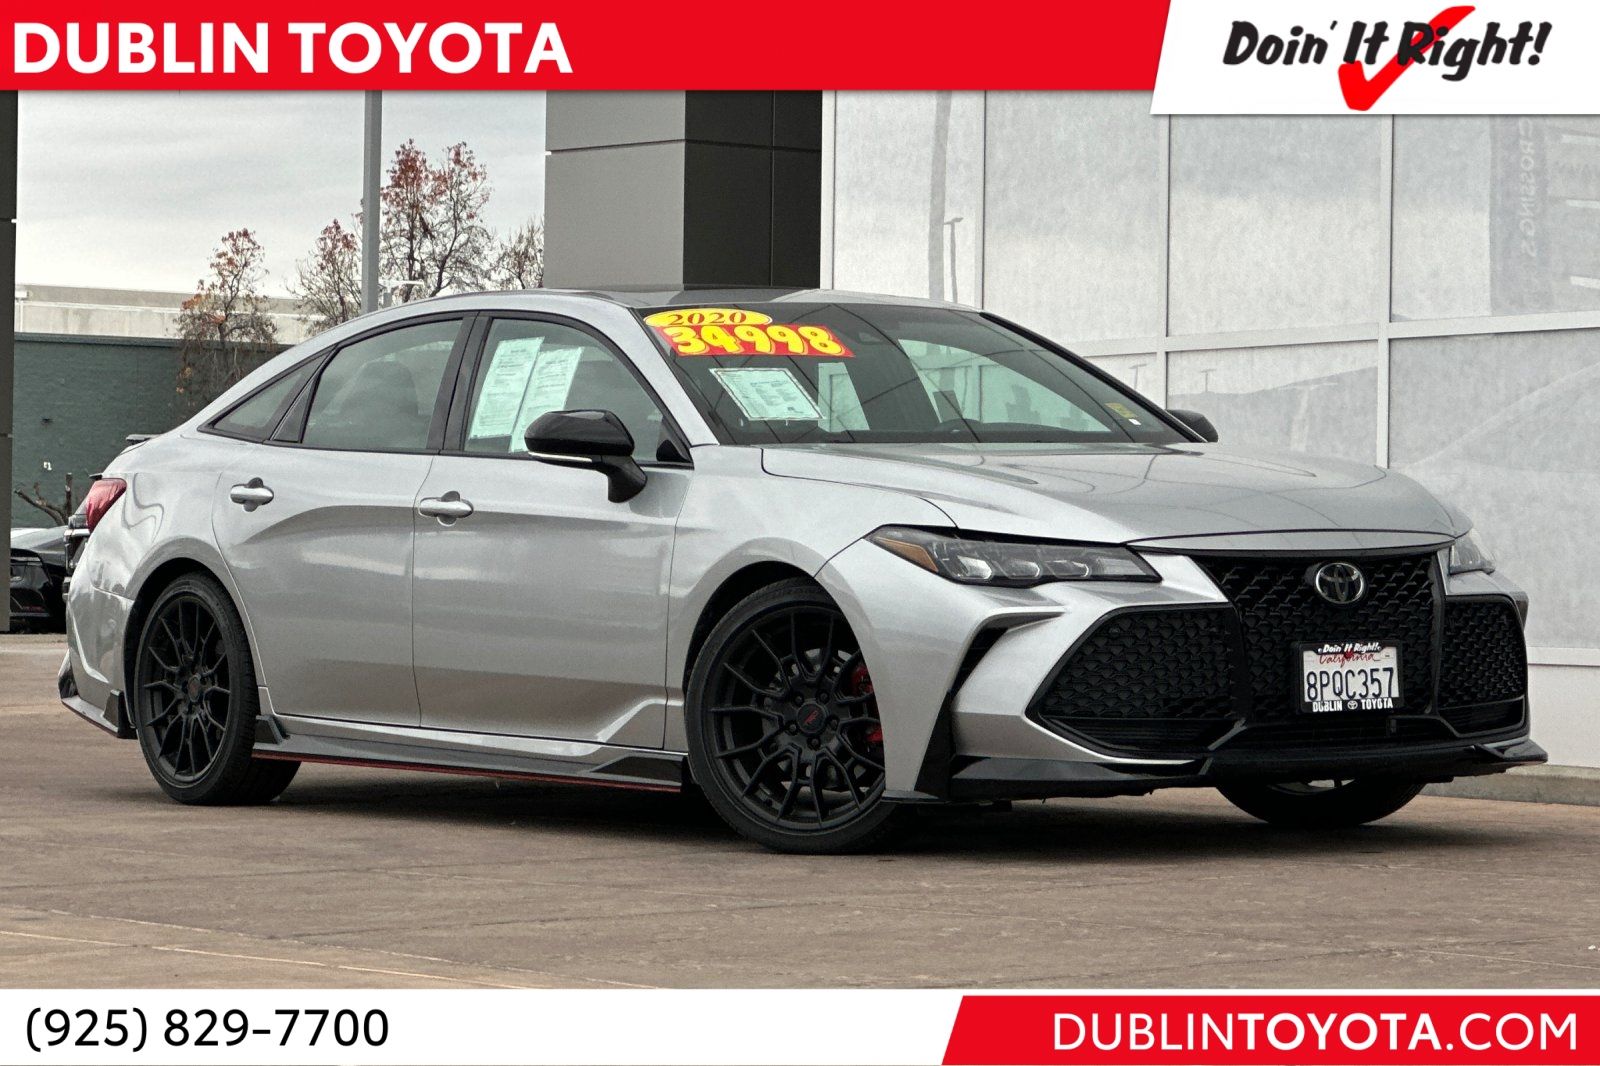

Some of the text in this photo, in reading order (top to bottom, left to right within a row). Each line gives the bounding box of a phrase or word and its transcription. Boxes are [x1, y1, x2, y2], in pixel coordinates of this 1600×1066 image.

[667, 311, 747, 326] 2020
[663, 325, 845, 356] 34998
[1306, 667, 1394, 701] 8PQC357
[1312, 697, 1394, 713] DUBLIN TOYOTA
